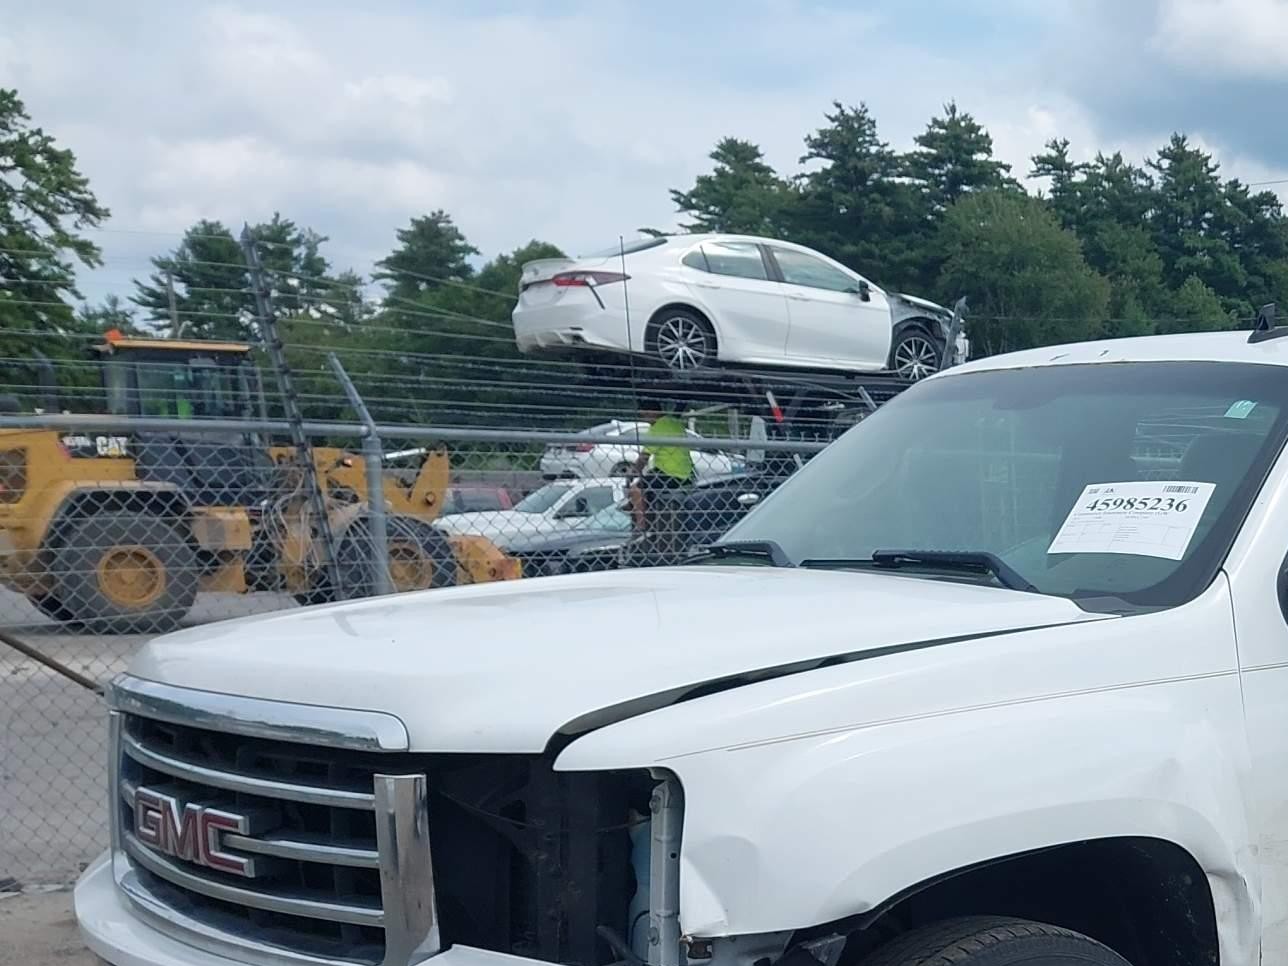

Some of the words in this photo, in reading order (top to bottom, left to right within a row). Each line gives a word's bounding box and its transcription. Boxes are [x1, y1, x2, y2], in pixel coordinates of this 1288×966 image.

[95, 436, 128, 457] CAT
[1086, 497, 1191, 513] 45985236
[134, 786, 256, 878] GMC
